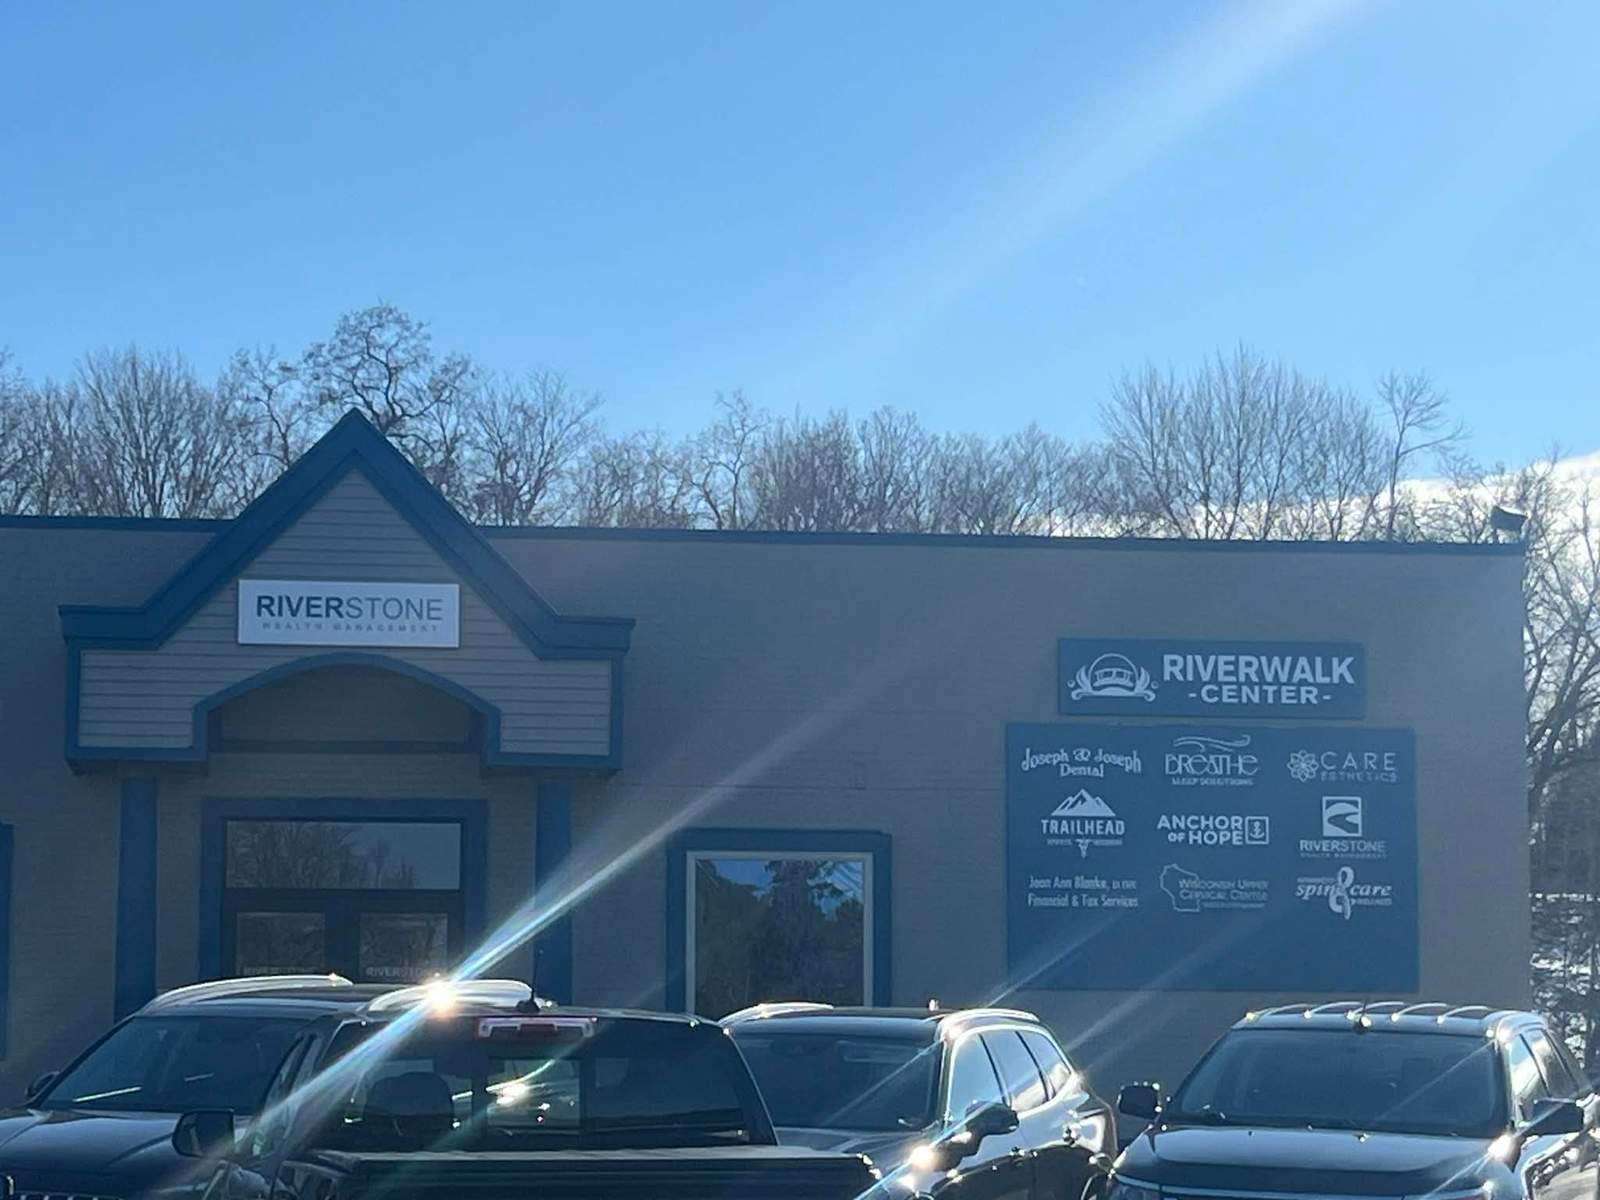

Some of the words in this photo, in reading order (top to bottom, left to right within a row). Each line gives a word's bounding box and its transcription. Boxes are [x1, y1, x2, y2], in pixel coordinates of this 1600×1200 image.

[256, 595, 443, 621] RIVERSTONE
[262, 621, 323, 631] WEALTH
[333, 623, 438, 633] MANAGEMENT
[1163, 654, 1355, 684] RIVERWALK
[1021, 747, 1069, 771] Joseph
[1073, 748, 1091, 762] &
[1094, 748, 1142, 773] Joseph
[1320, 752, 1397, 771] CARE
[1060, 763, 1105, 778] Dental
[1320, 771, 1397, 783] ESTHETICS
[1041, 819, 1125, 835] TRAILHEAD
[1157, 815, 1243, 830] ANCHOR
[1168, 832, 1185, 843] OF
[1188, 831, 1244, 845] HOPE
[1300, 839, 1386, 852] RIVERSTONE
[1028, 893, 1069, 907] Financial
[1072, 895, 1080, 907] &
[1081, 894, 1099, 907] Tax
[1101, 894, 1139, 907] Services
